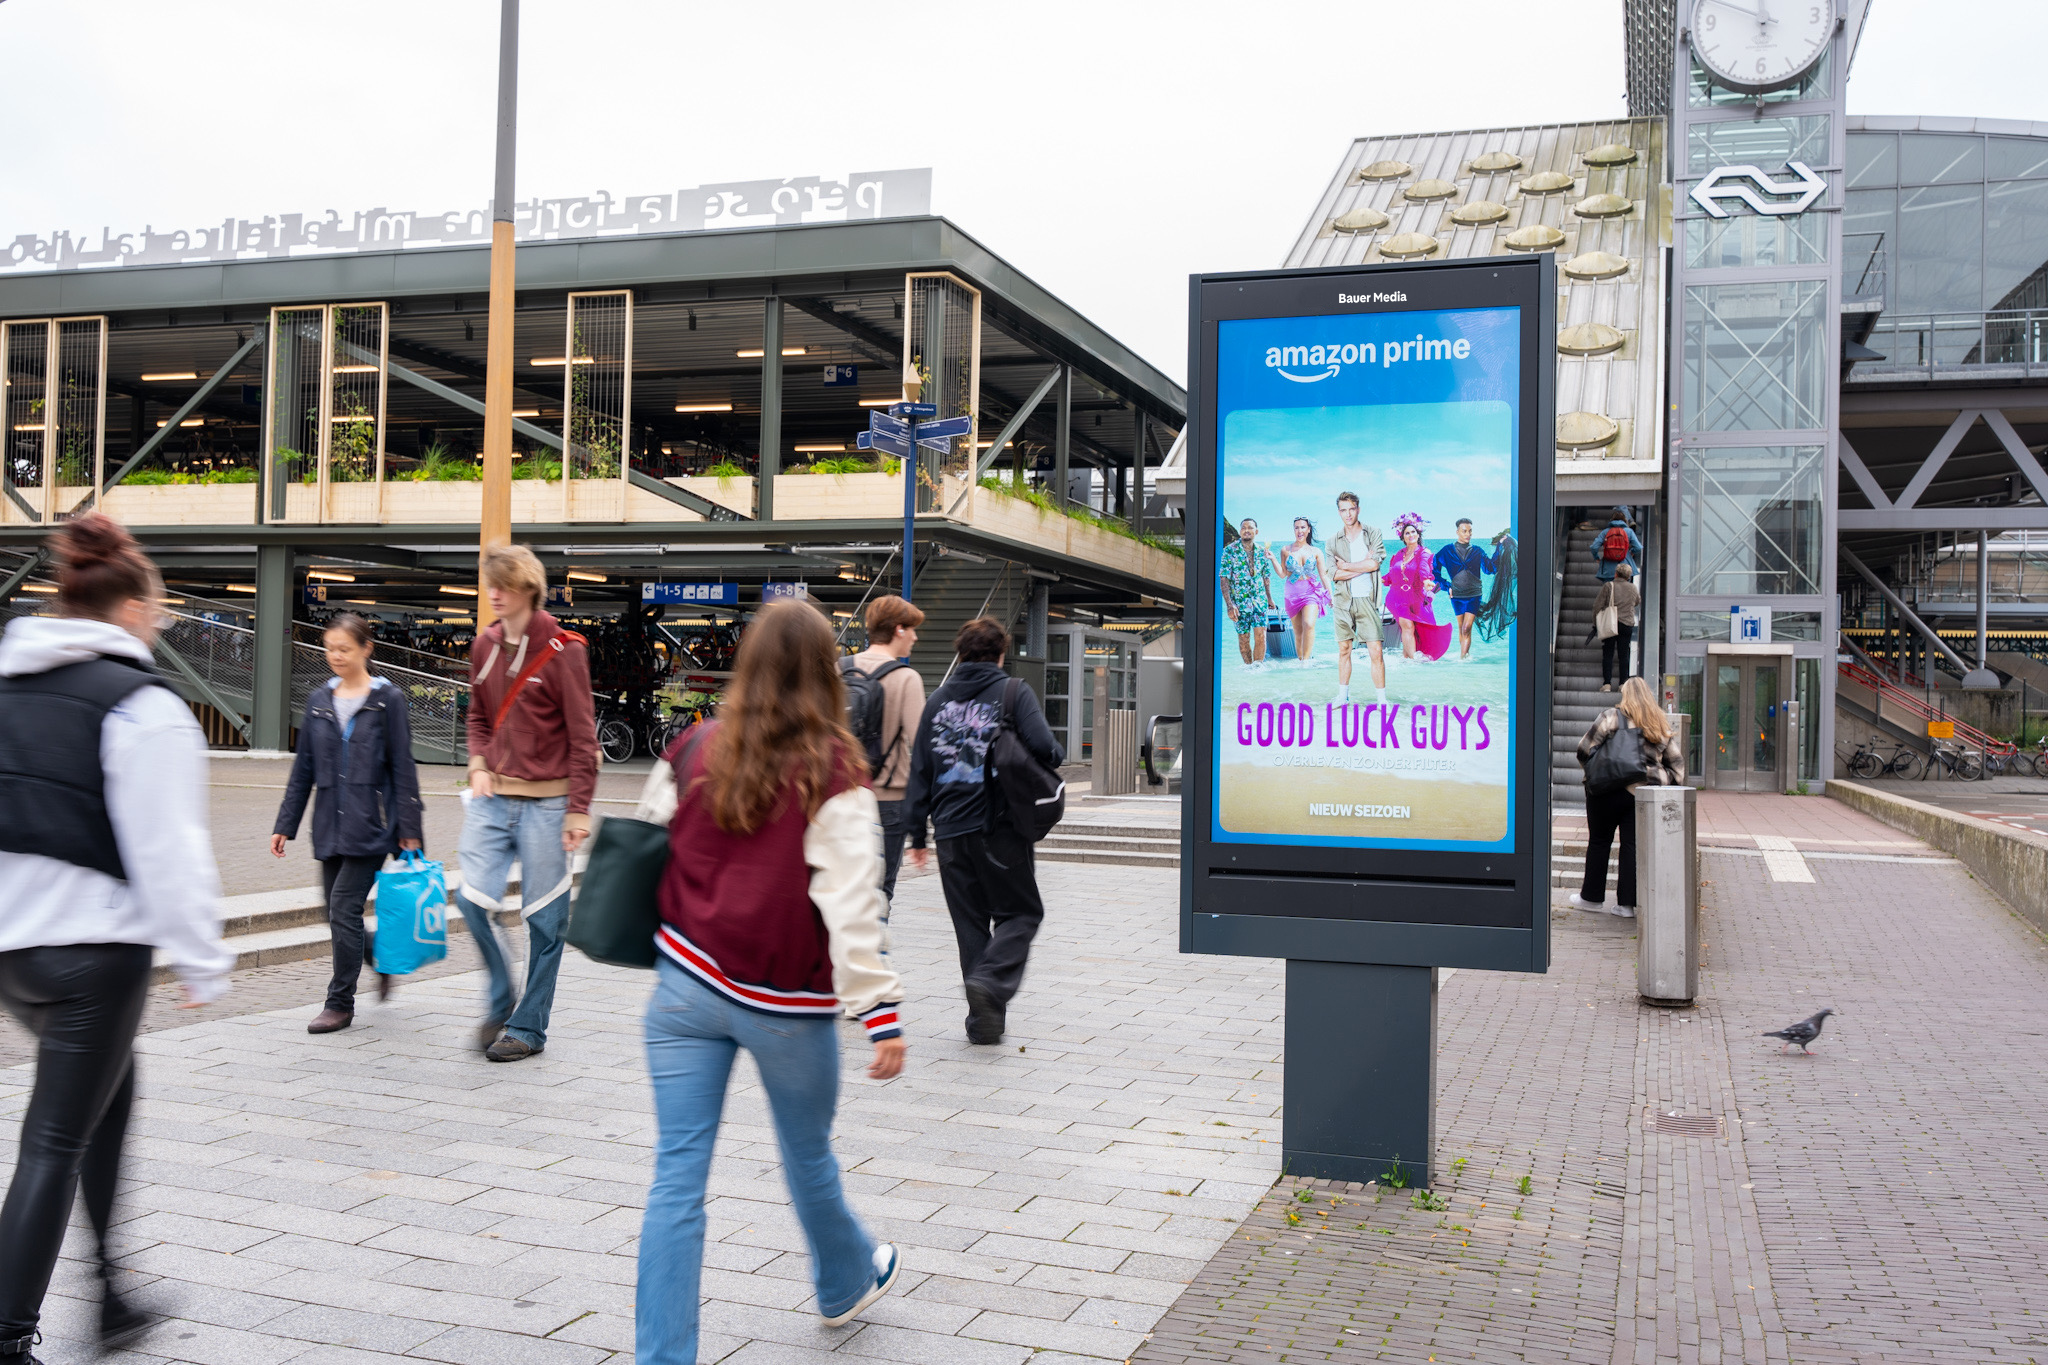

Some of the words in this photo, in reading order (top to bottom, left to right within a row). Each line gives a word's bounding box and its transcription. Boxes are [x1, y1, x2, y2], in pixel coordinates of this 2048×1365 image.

[1705, 14, 1717, 32] 9
[1809, 7, 1821, 25] 3
[1755, 57, 1767, 75] 6
[1338, 292, 1371, 304] Bauer
[1373, 290, 1407, 303] Media
[1265, 342, 1376, 368] amazon
[1383, 334, 1471, 368] prime
[845, 367, 852, 378] 6
[663, 585, 681, 596] 1-5
[774, 584, 793, 596] 6-8
[1237, 702, 1314, 748] GOOD
[1325, 703, 1400, 749] LUCK
[1410, 704, 1491, 751] GUYS
[1272, 754, 1351, 769] OVERLEVEN
[1353, 755, 1412, 770] ZONDER
[1414, 757, 1456, 771] FILTER
[1309, 802, 1353, 817] NIEUW
[1354, 804, 1411, 819] SEIZOEN
